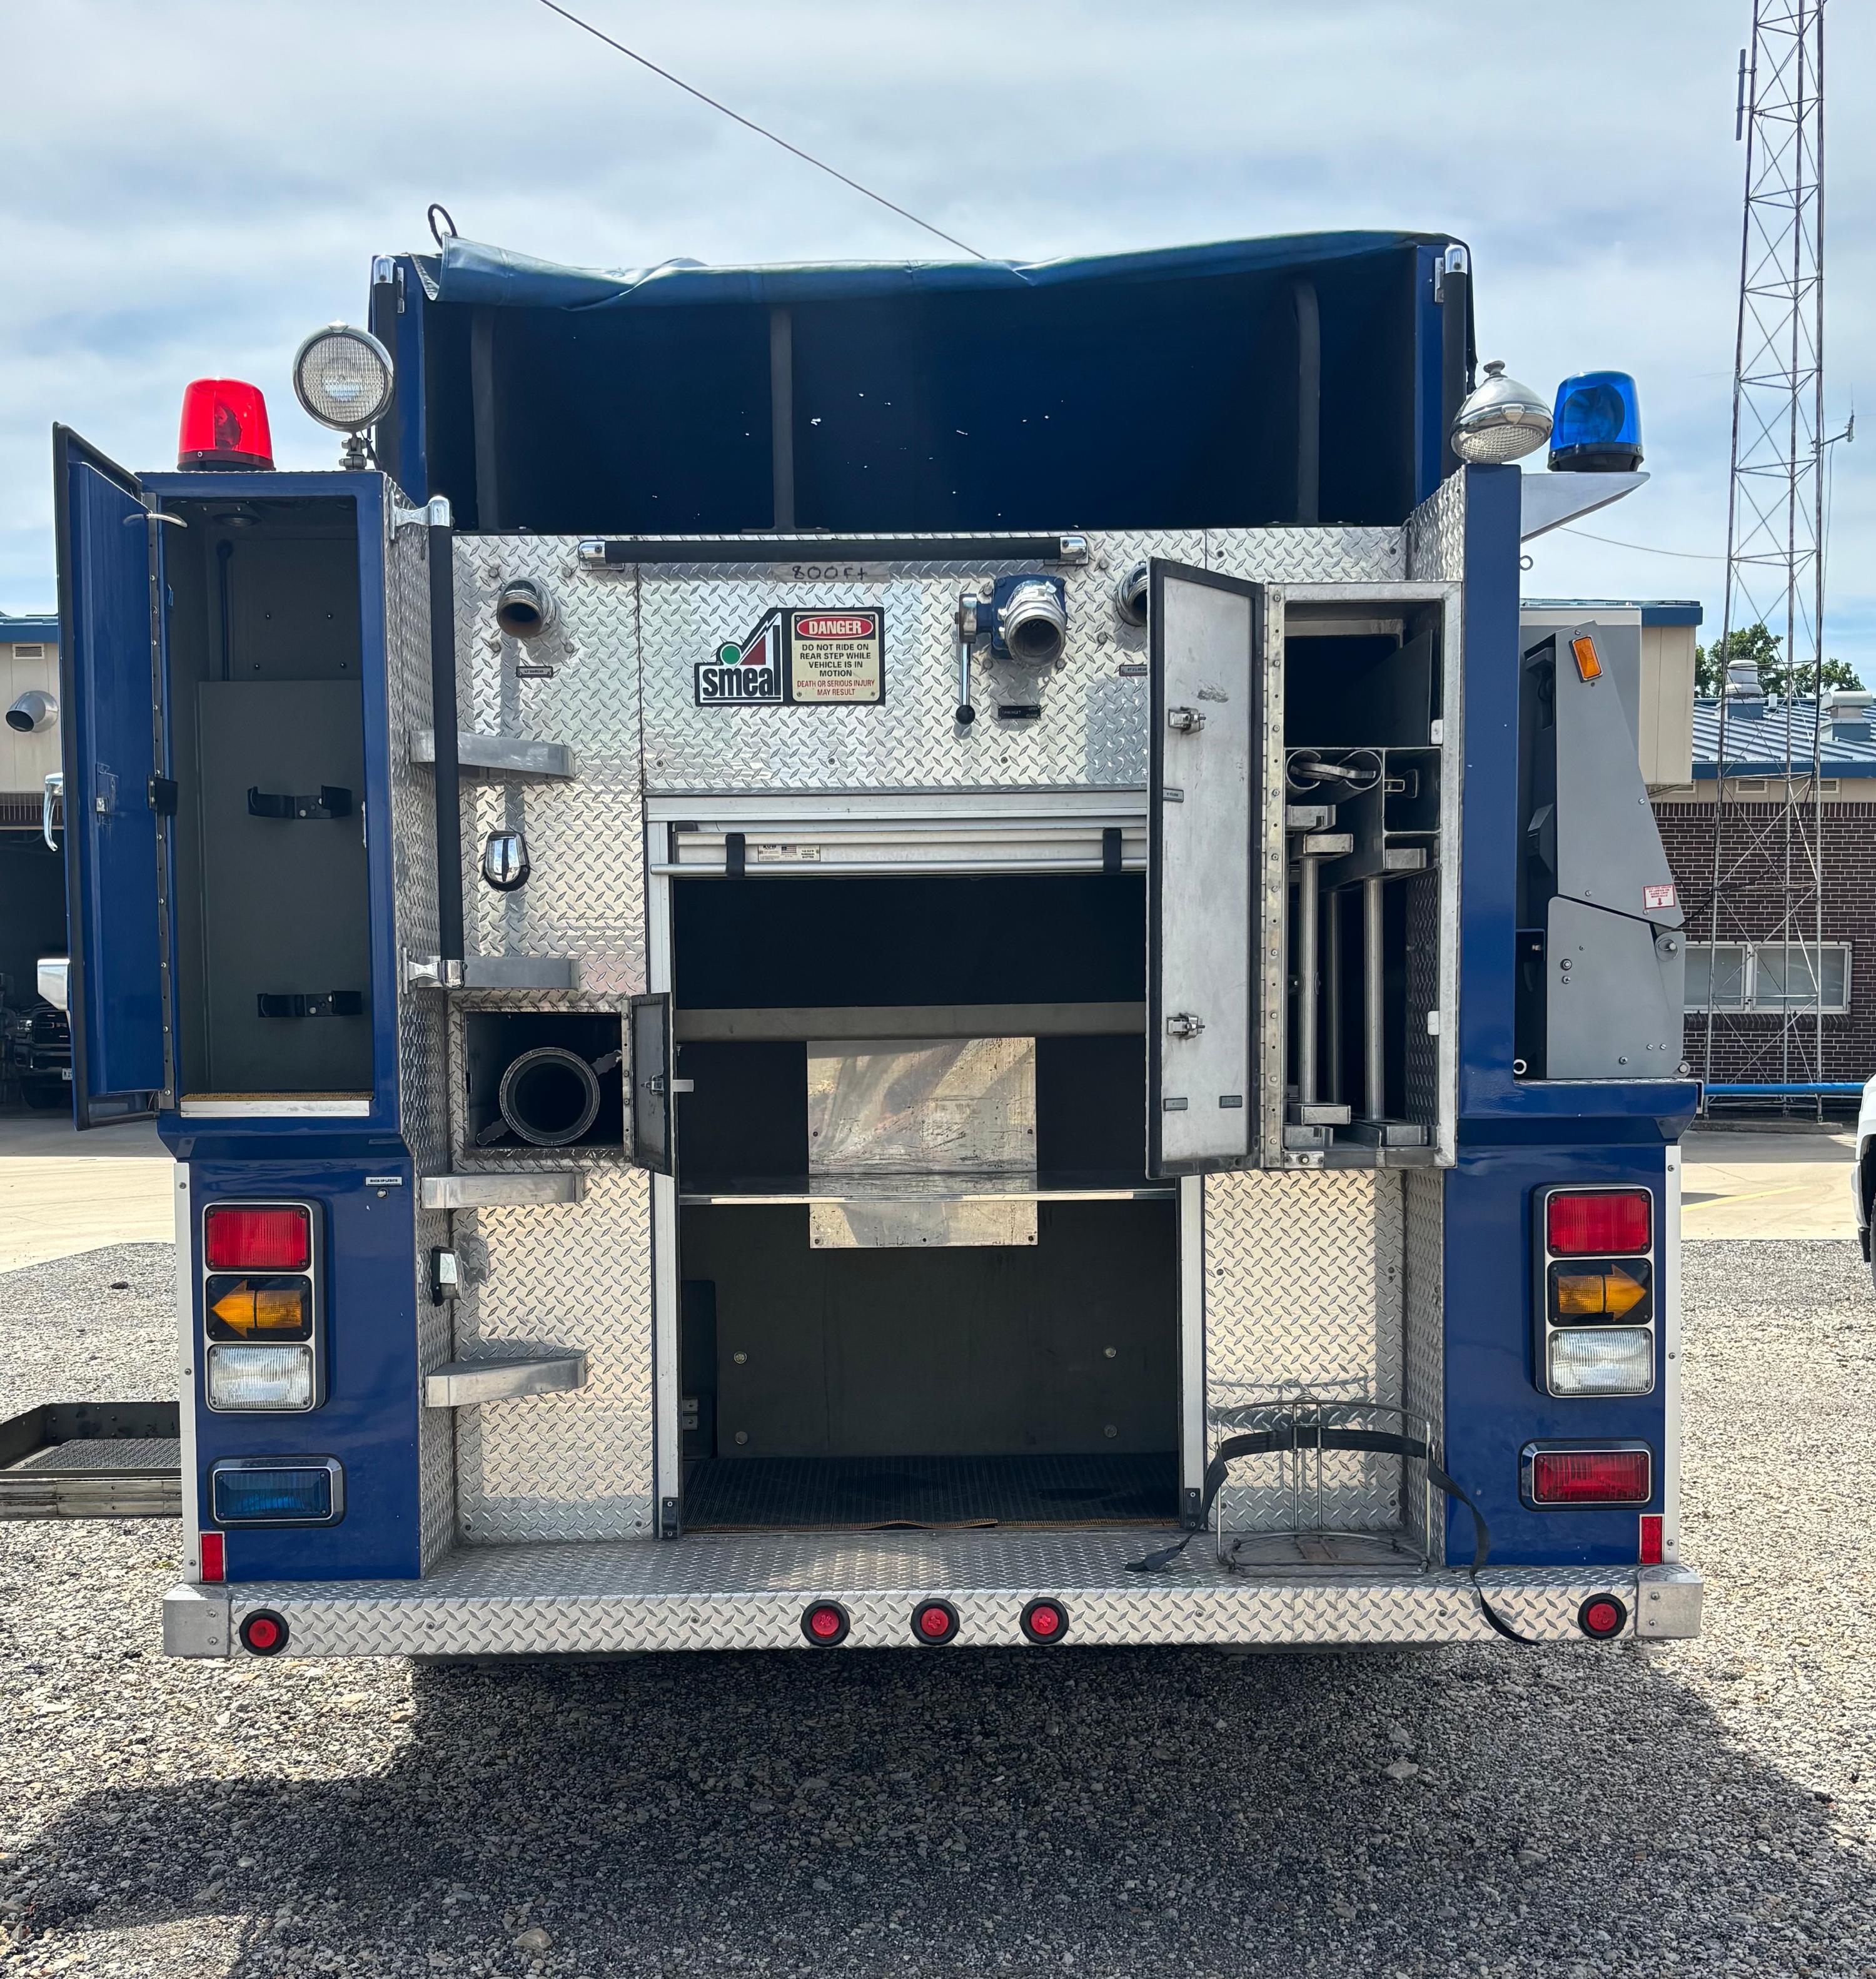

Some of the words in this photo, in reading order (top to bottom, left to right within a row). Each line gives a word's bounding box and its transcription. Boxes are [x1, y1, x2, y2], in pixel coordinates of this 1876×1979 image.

[792, 565, 838, 580] 800
[809, 620, 862, 634] DANGER
[702, 625, 781, 697] smeal
